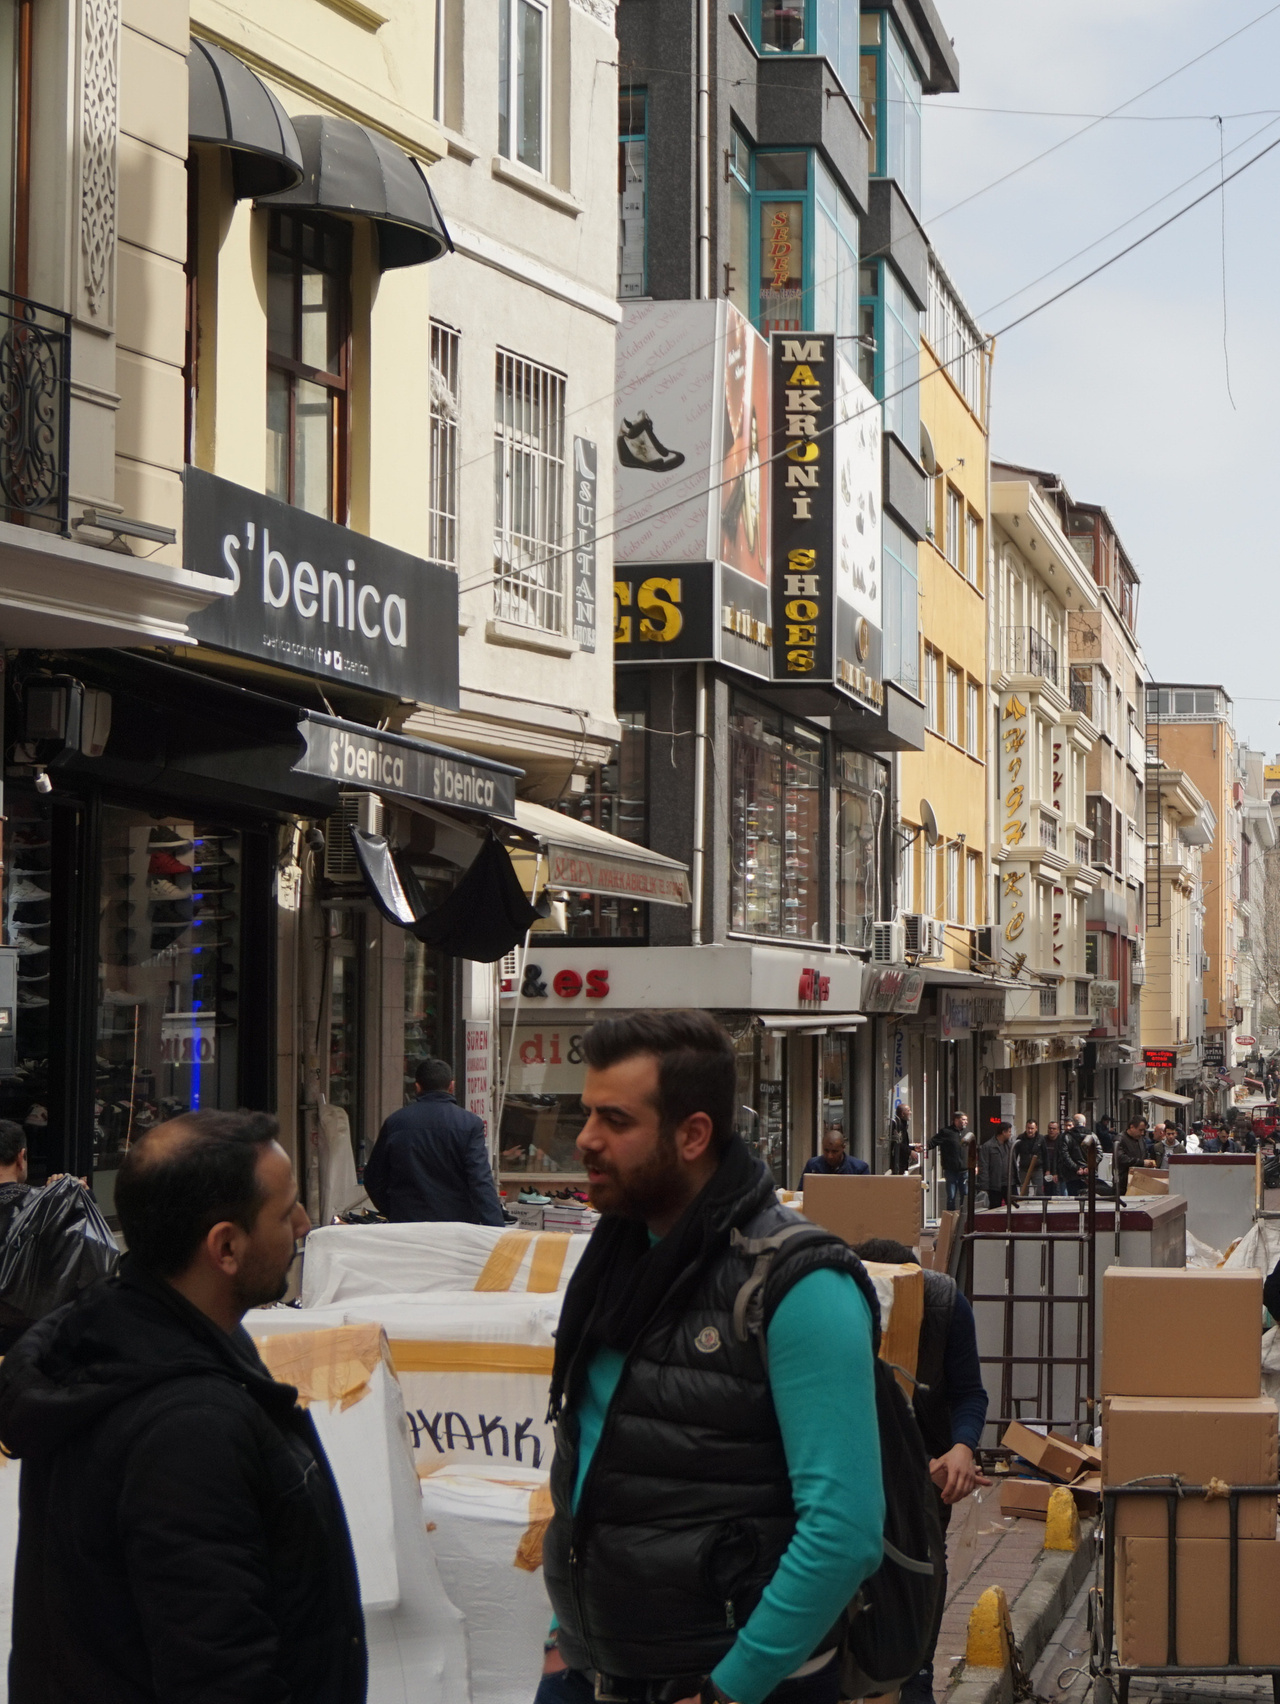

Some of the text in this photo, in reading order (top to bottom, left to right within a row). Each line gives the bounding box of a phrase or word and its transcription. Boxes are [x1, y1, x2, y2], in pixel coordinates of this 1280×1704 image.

[768, 211, 792, 287] SEDEF
[575, 480, 595, 626] SULTAN
[781, 339, 826, 673] MAKRONİ SHOES
[223, 521, 408, 648] s'benica
[329, 734, 495, 808] s'benica s'benica
[466, 1030, 489, 1052] SÜREN
